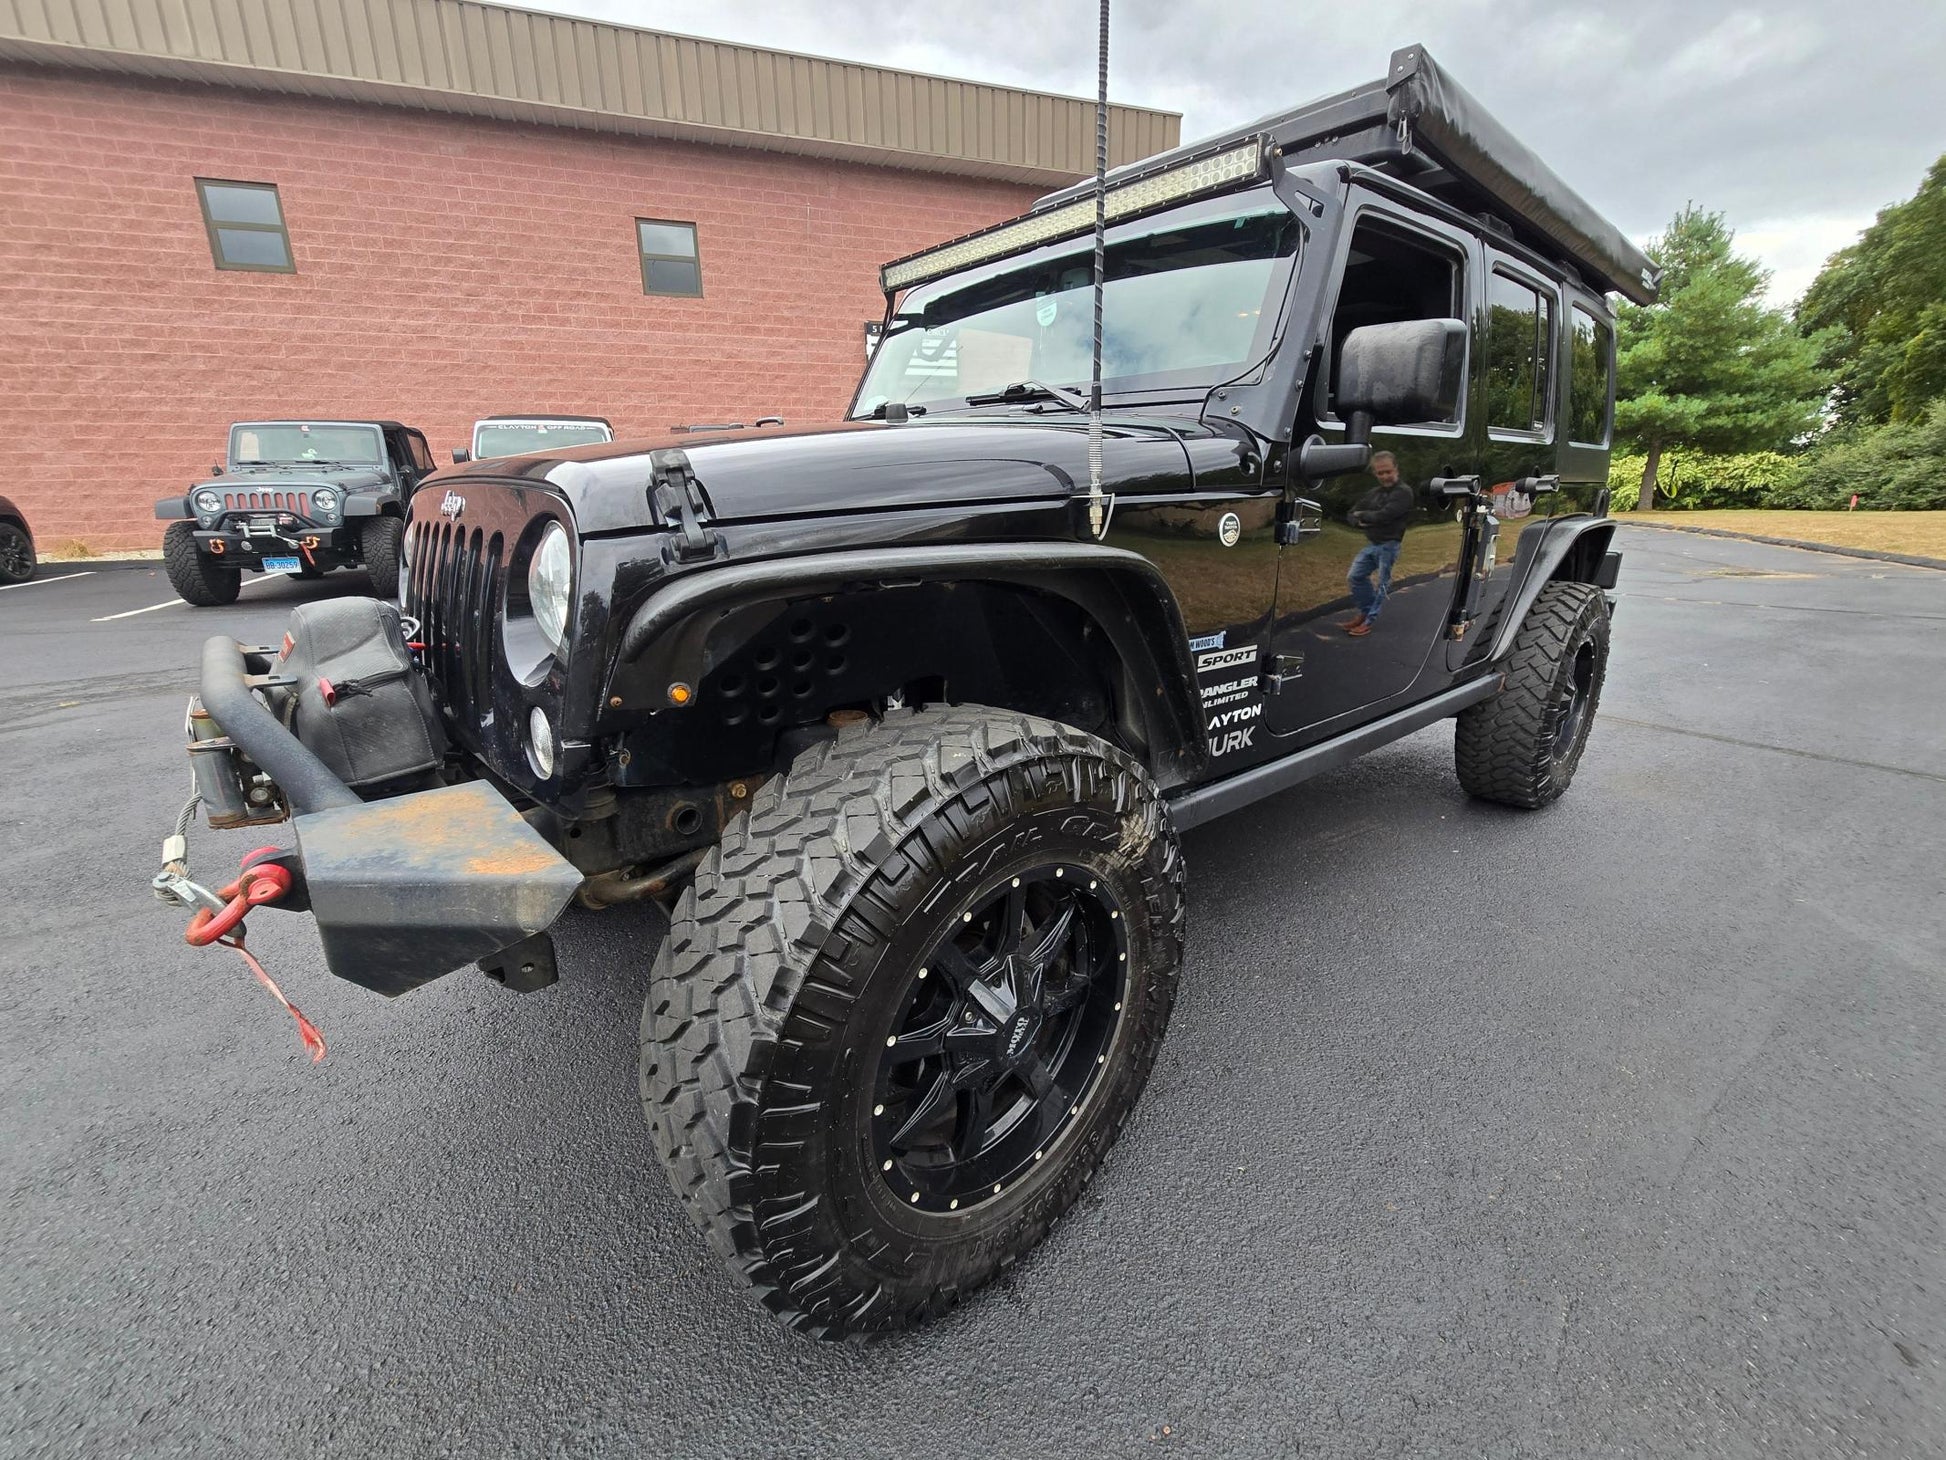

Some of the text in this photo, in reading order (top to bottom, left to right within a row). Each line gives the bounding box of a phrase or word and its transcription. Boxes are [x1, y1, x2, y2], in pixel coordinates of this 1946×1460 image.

[1201, 649, 1255, 667] SPORT
[1200, 676, 1259, 699] ANGLER
[1202, 691, 1249, 709] NLIMITED
[1207, 703, 1262, 730] AYTON
